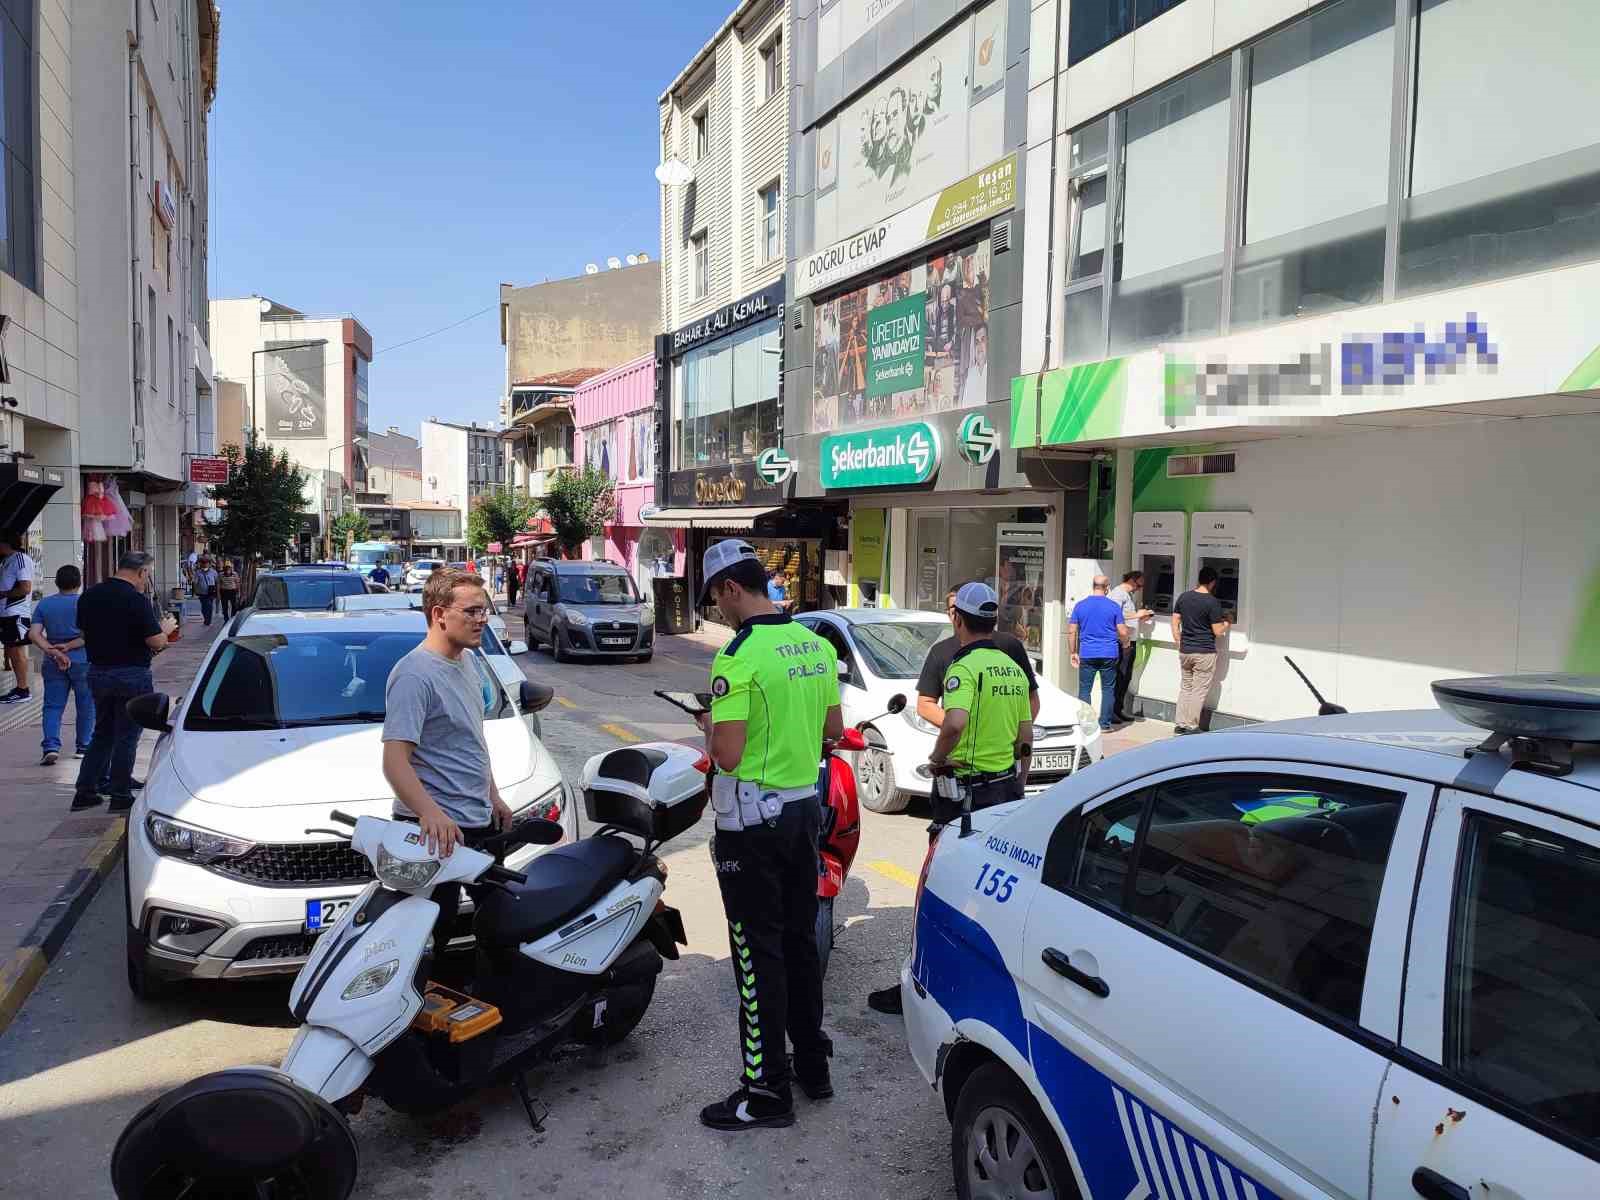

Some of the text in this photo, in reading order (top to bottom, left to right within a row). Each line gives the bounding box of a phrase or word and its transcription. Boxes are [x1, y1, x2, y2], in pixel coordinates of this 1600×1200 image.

[809, 245, 845, 278] DOĞRU
[849, 227, 887, 260] CEVAP
[674, 325, 703, 349] BAHAR
[704, 319, 712, 337] &
[732, 295, 768, 323] KEMAL
[871, 309, 921, 345] ÜRETENİN
[871, 334, 920, 361] YANINDAYIZ!
[875, 363, 905, 384] Şekerbank
[831, 434, 905, 481] Şekerbank
[1045, 754, 1069, 768] 5503
[1009, 840, 1043, 870] İMDAT
[975, 862, 1019, 904] 155
[561, 951, 588, 967] pion
